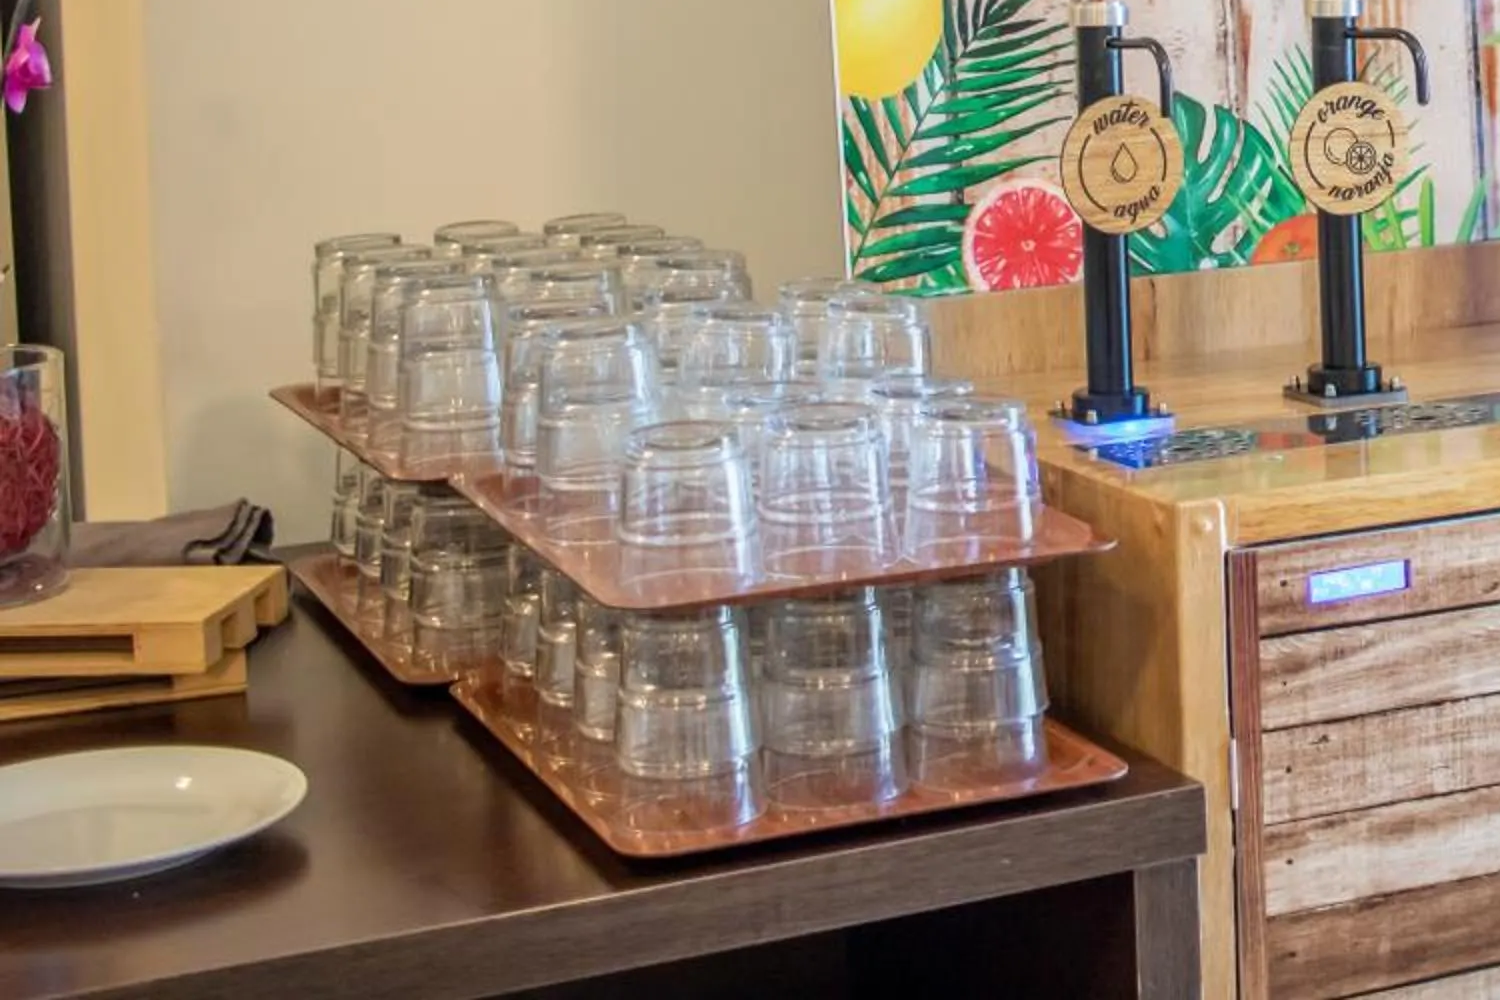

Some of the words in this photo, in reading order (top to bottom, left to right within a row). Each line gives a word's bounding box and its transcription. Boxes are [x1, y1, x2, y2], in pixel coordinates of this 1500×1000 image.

[1093, 101, 1149, 135] water
[1317, 95, 1385, 123] orange
[1328, 152, 1394, 200] naranja
[1113, 185, 1160, 224] agua
